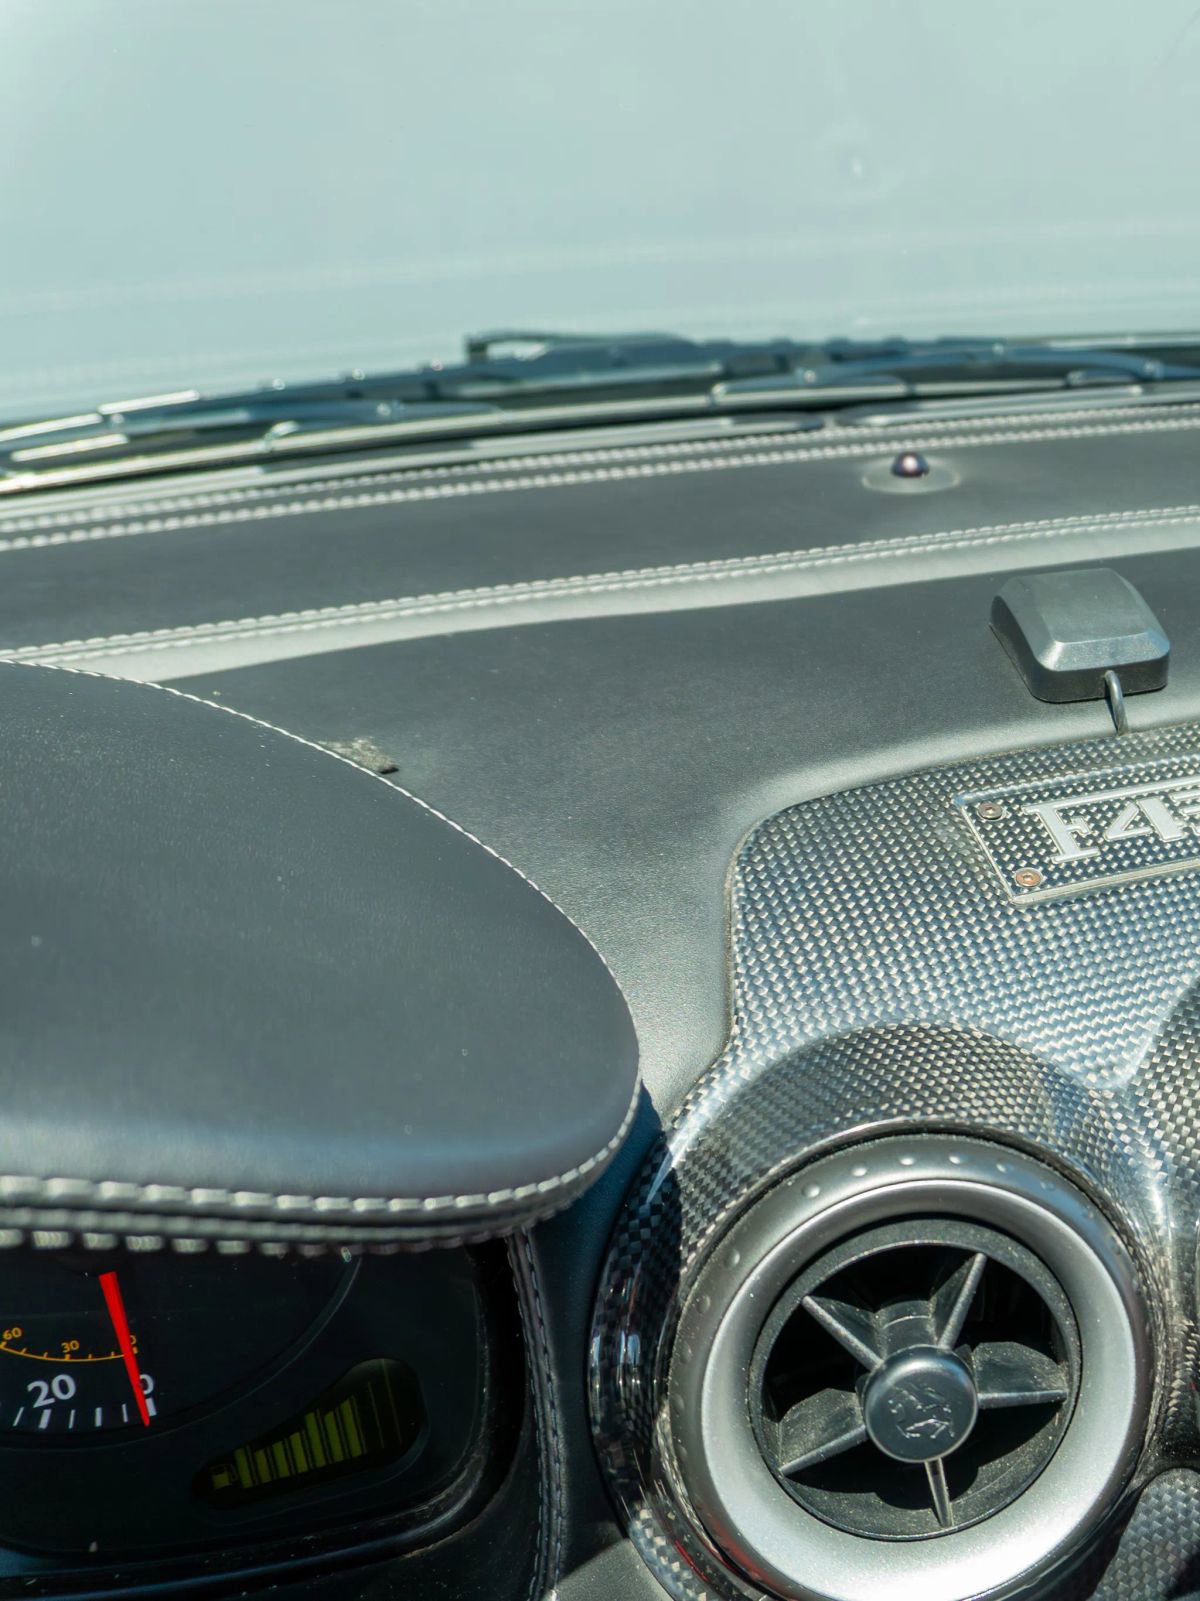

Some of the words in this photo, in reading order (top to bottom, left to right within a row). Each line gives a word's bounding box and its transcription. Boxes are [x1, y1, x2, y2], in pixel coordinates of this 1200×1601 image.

[3, 1327, 22, 1340] 60
[60, 1339, 81, 1353] 30
[27, 1373, 77, 1409] 20
